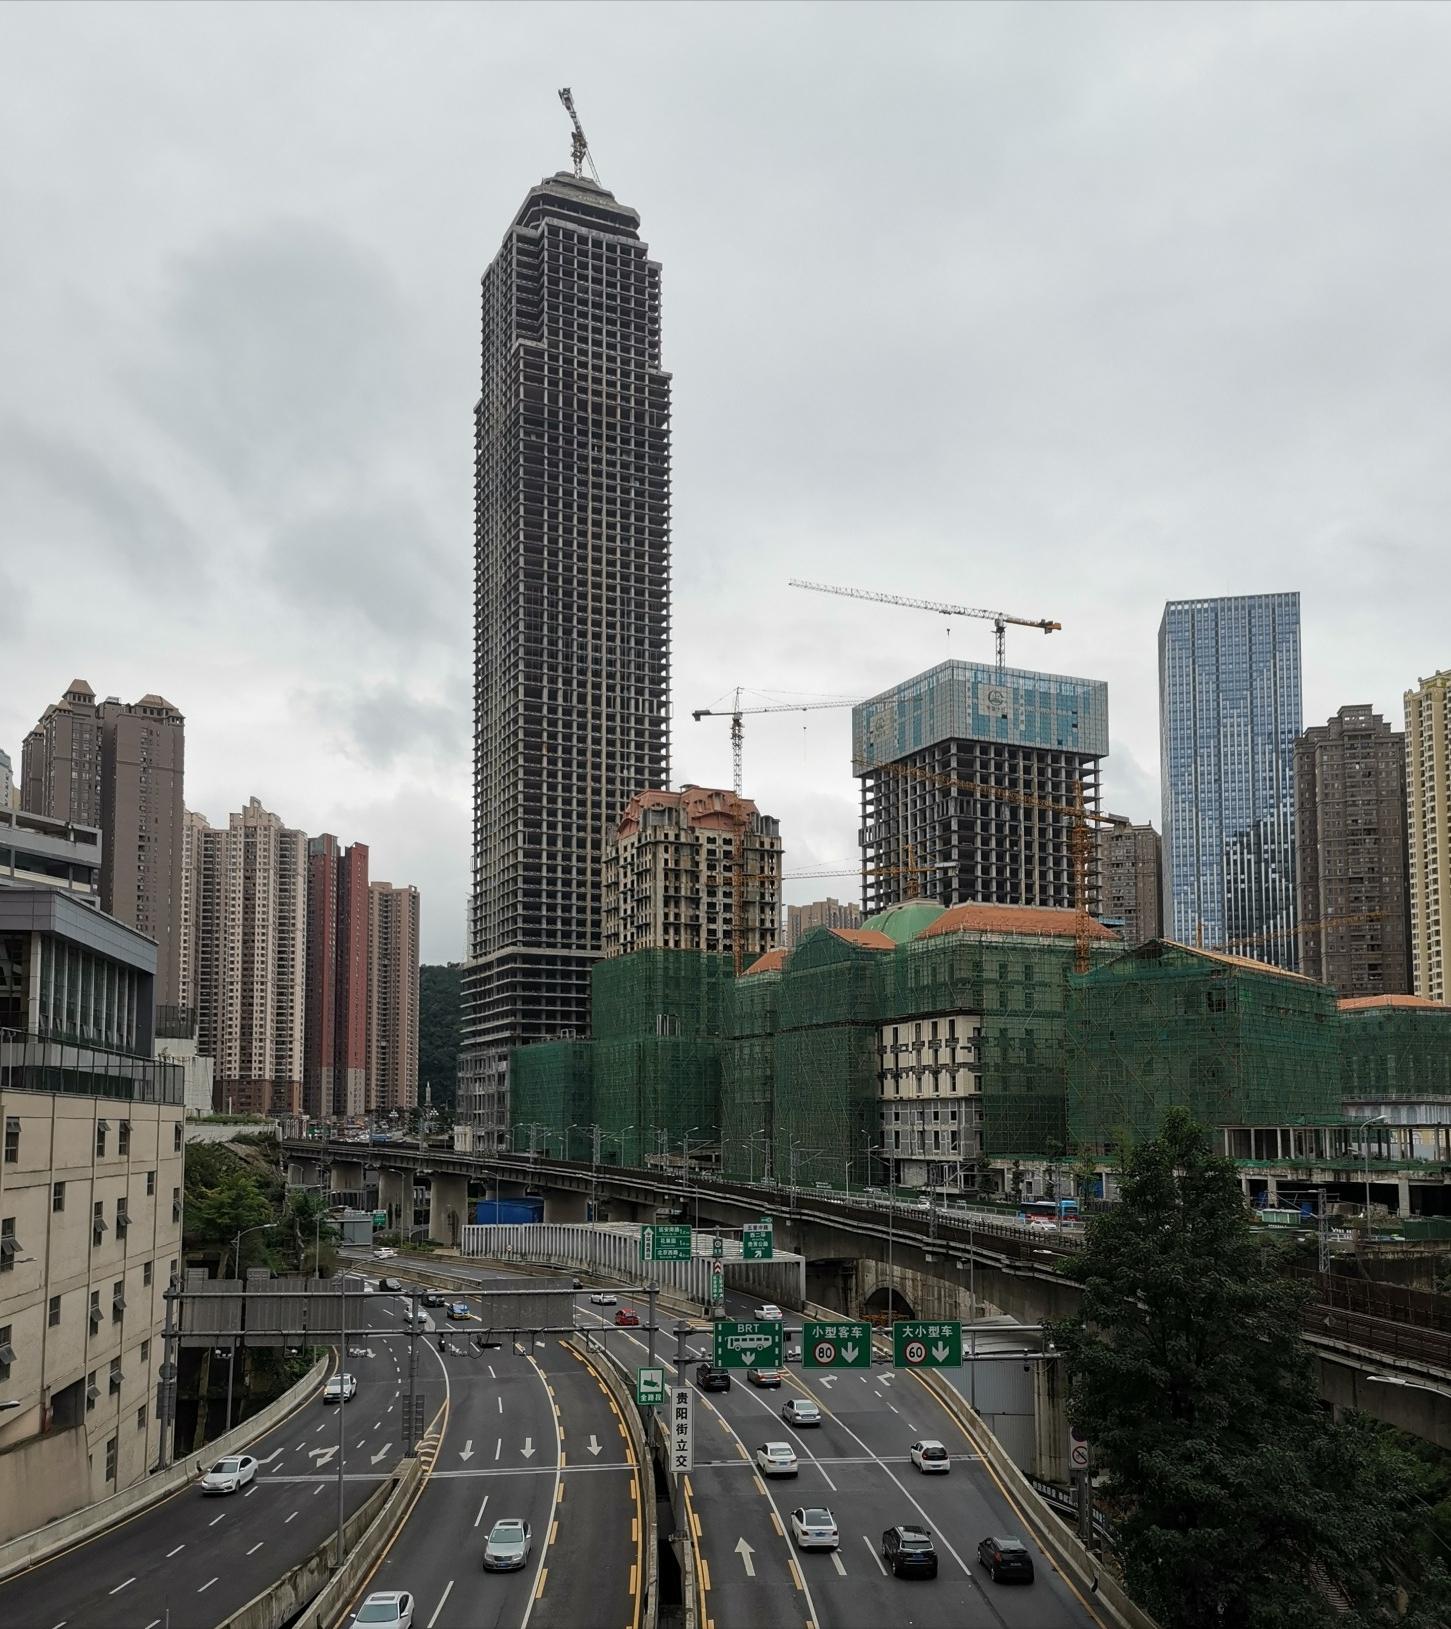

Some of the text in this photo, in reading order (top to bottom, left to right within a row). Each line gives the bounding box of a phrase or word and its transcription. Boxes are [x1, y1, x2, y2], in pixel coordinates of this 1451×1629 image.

[737, 1323, 760, 1333] BRT
[812, 1325, 864, 1338] 小型客车
[901, 1325, 953, 1338] 大小型车
[818, 1346, 833, 1359] 80
[908, 1346, 923, 1359] 60
[640, 1393, 662, 1402] 全路段
[675, 1391, 689, 1468] 贵阳街立交
